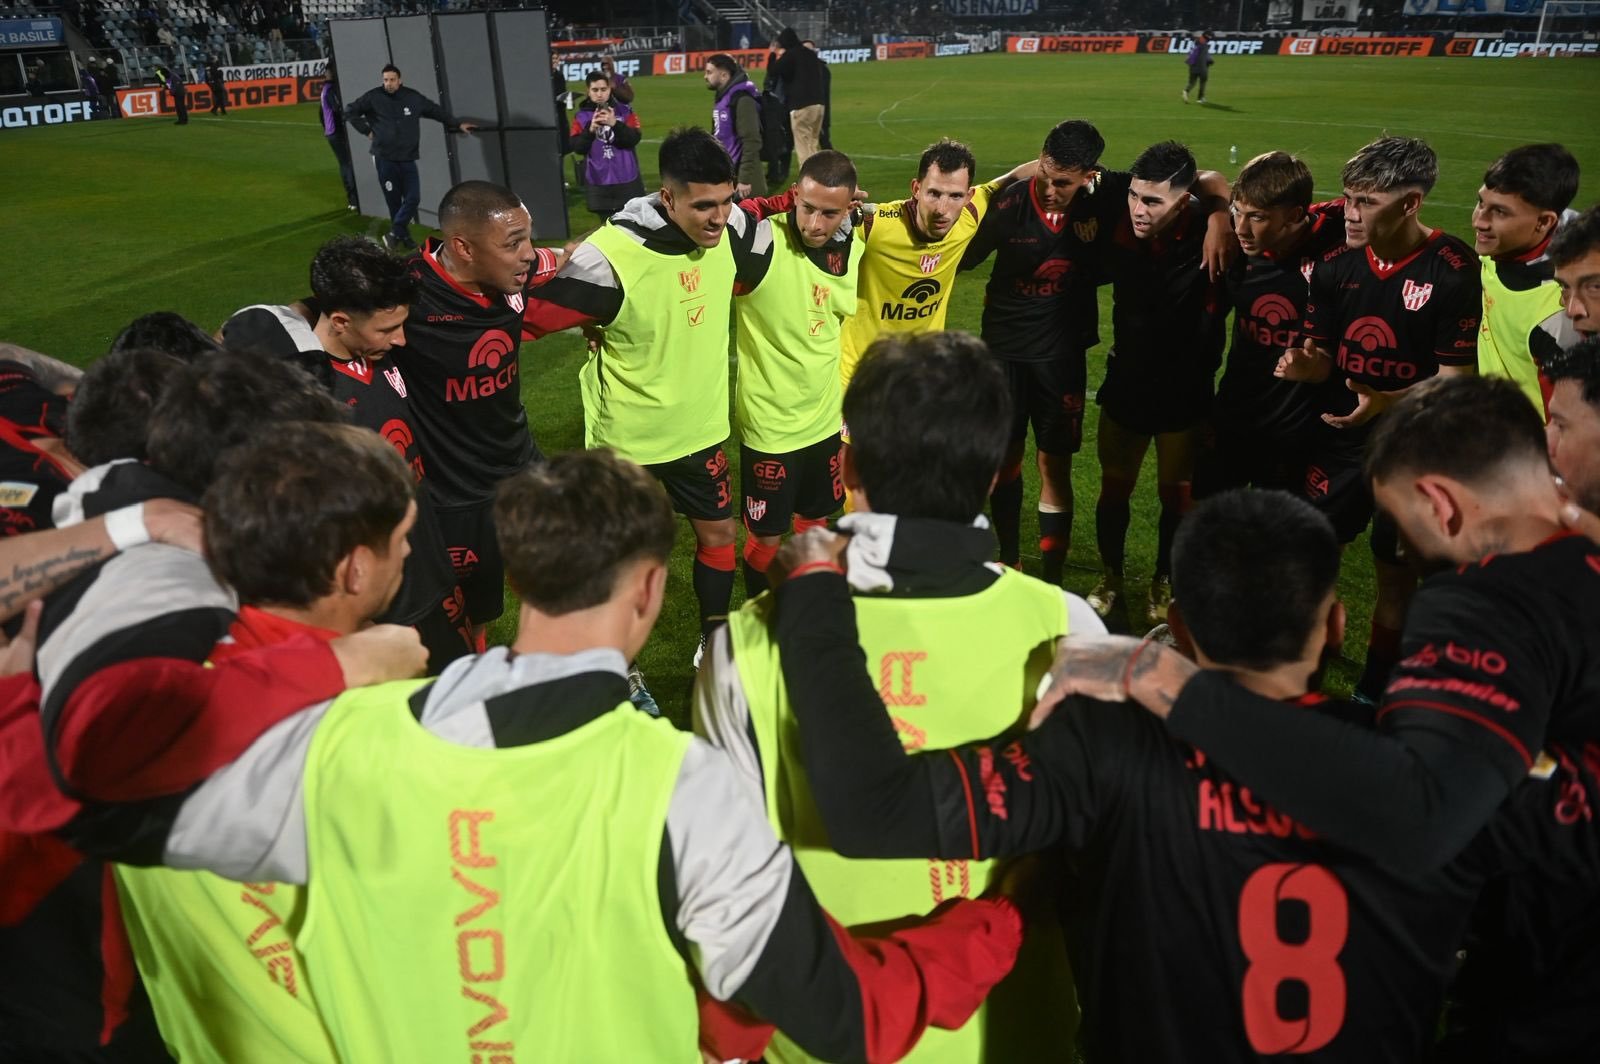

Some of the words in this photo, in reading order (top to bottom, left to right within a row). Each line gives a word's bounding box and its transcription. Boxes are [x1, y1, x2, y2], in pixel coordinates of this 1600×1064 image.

[10, 30, 56, 43] BASILE
[245, 67, 276, 81] PIBES
[279, 65, 293, 78] DE
[297, 62, 309, 77] LA
[753, 462, 786, 480] GEA
[1237, 860, 1349, 1056] 8
